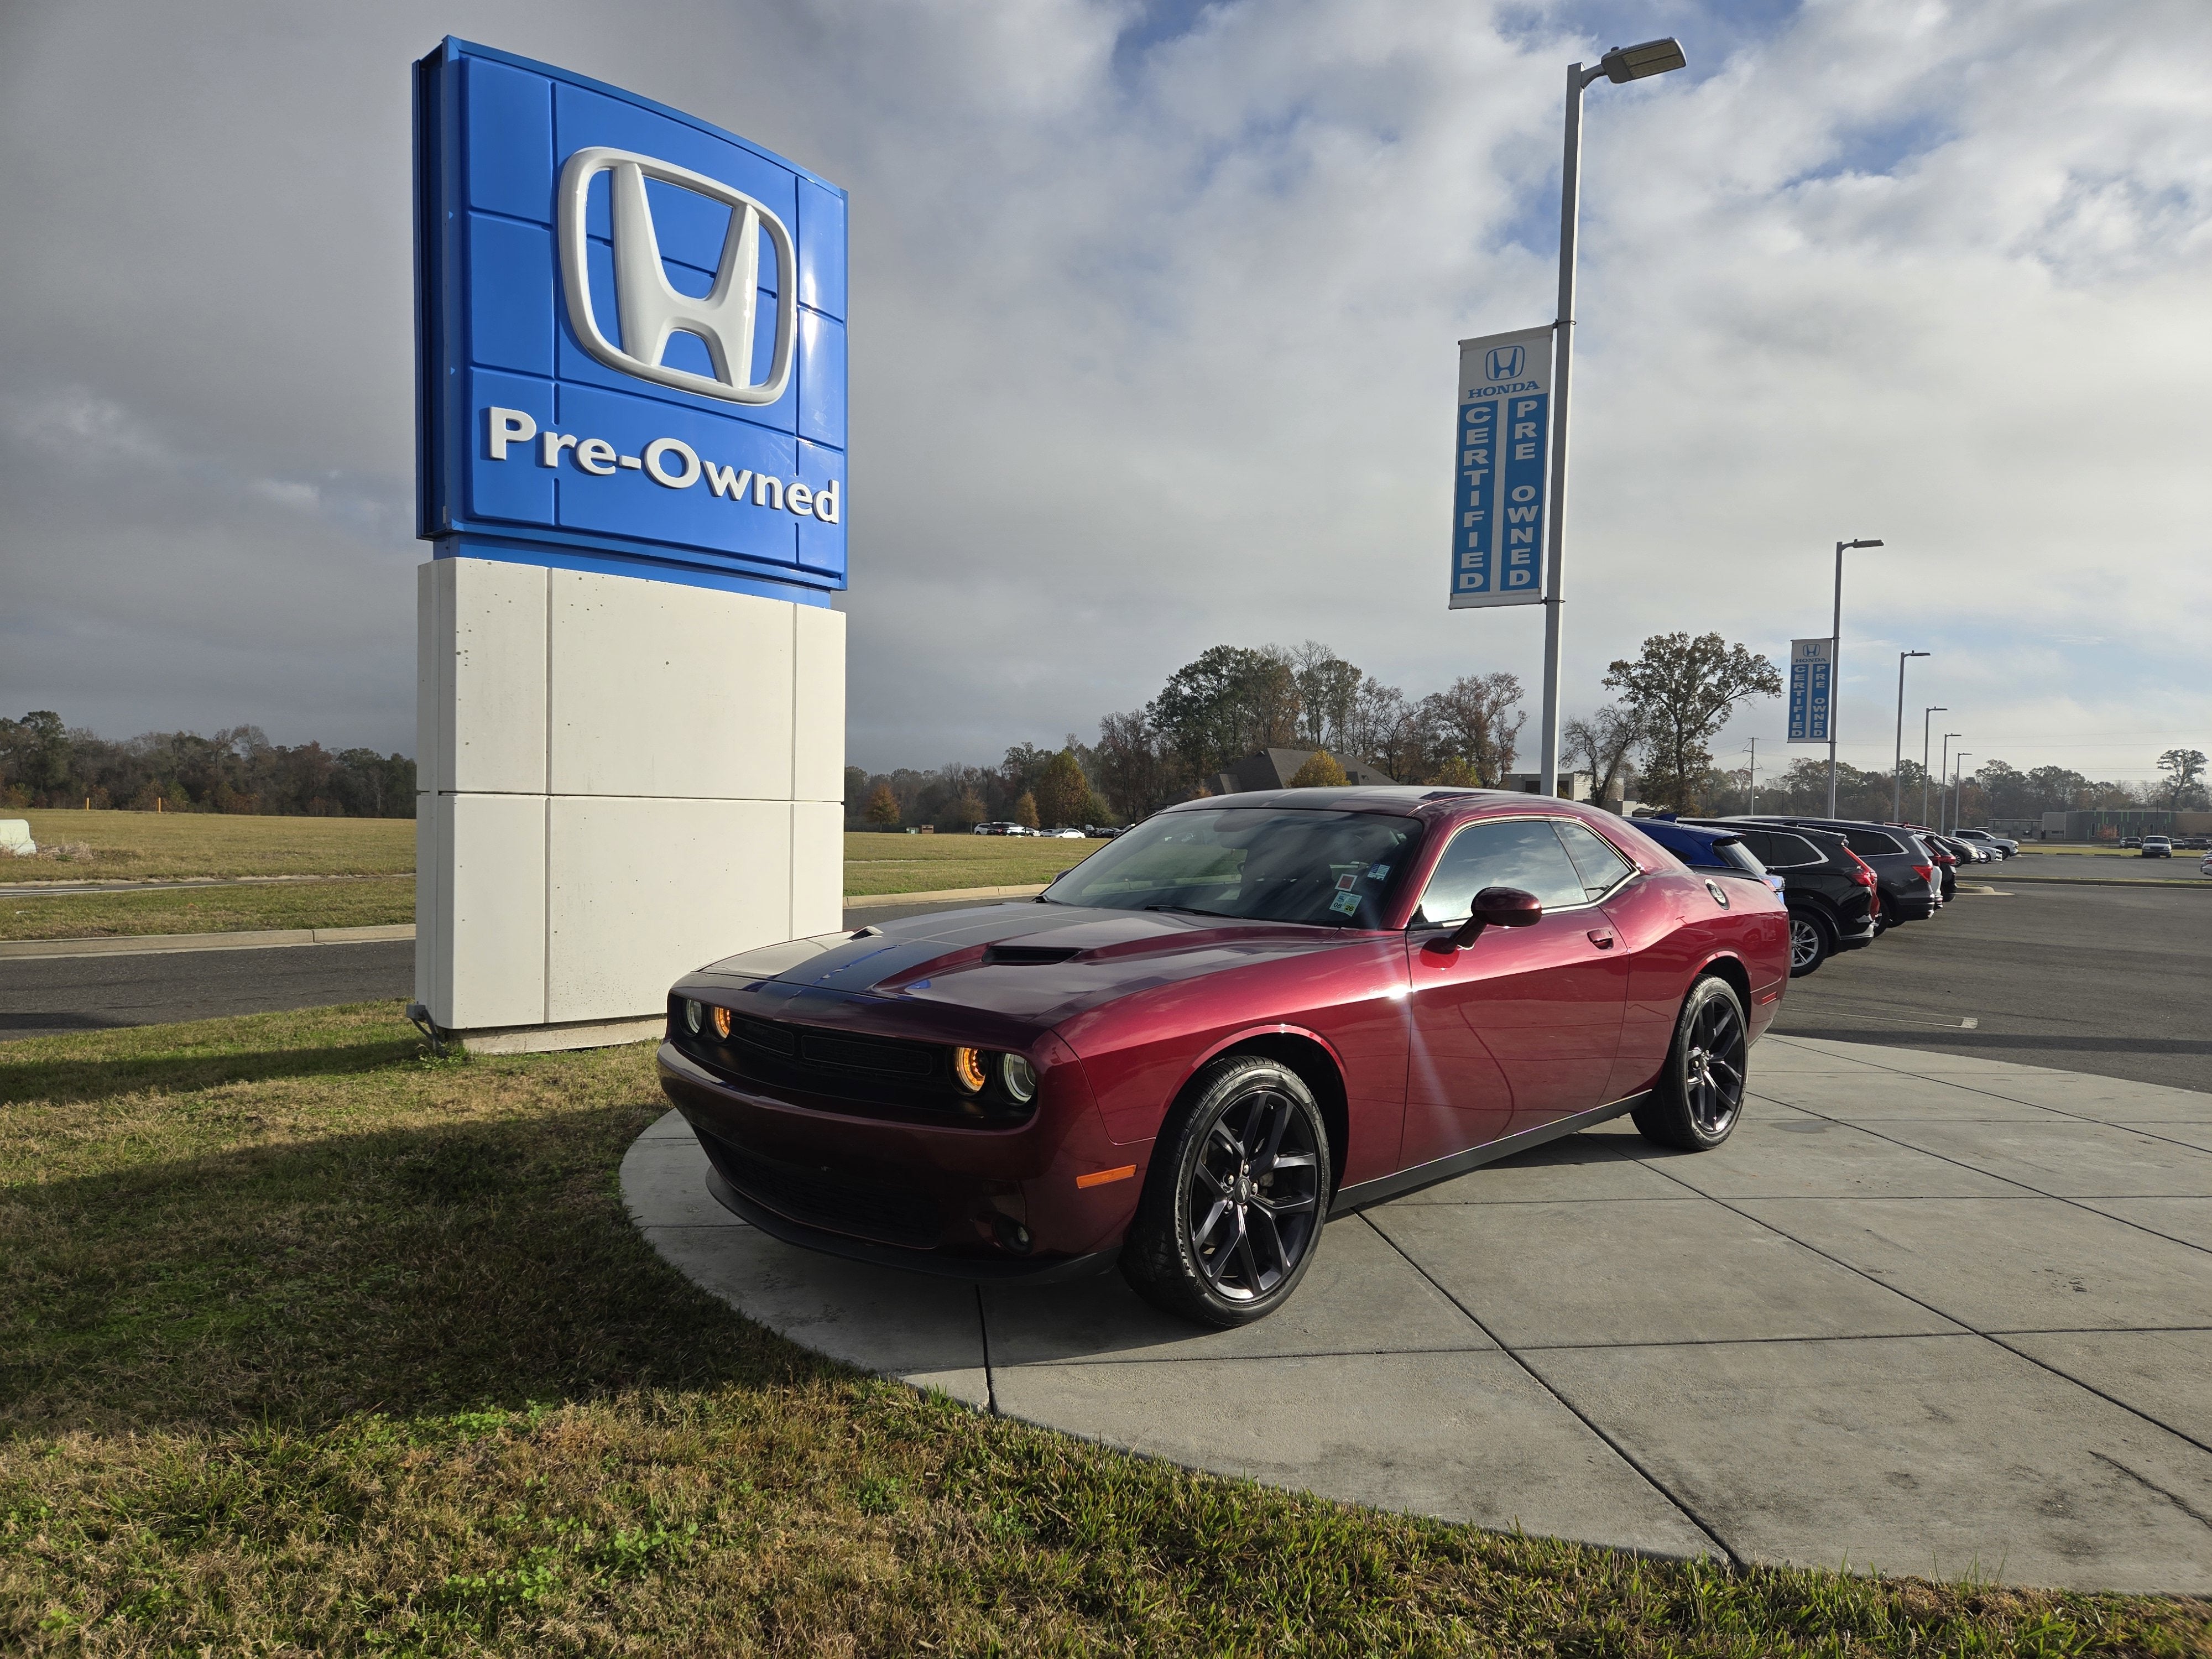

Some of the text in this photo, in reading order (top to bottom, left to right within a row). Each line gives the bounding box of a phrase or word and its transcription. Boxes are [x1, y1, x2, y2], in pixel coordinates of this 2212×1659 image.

[1467, 380, 1541, 399] HONDA
[488, 406, 839, 524] Pre-Owned
[1459, 406, 1492, 589] CERTIFIED
[1507, 400, 1539, 587] PRE OWNED
[1791, 666, 1806, 737] CERTIFIED
[1813, 665, 1827, 737] PRE OWNED
